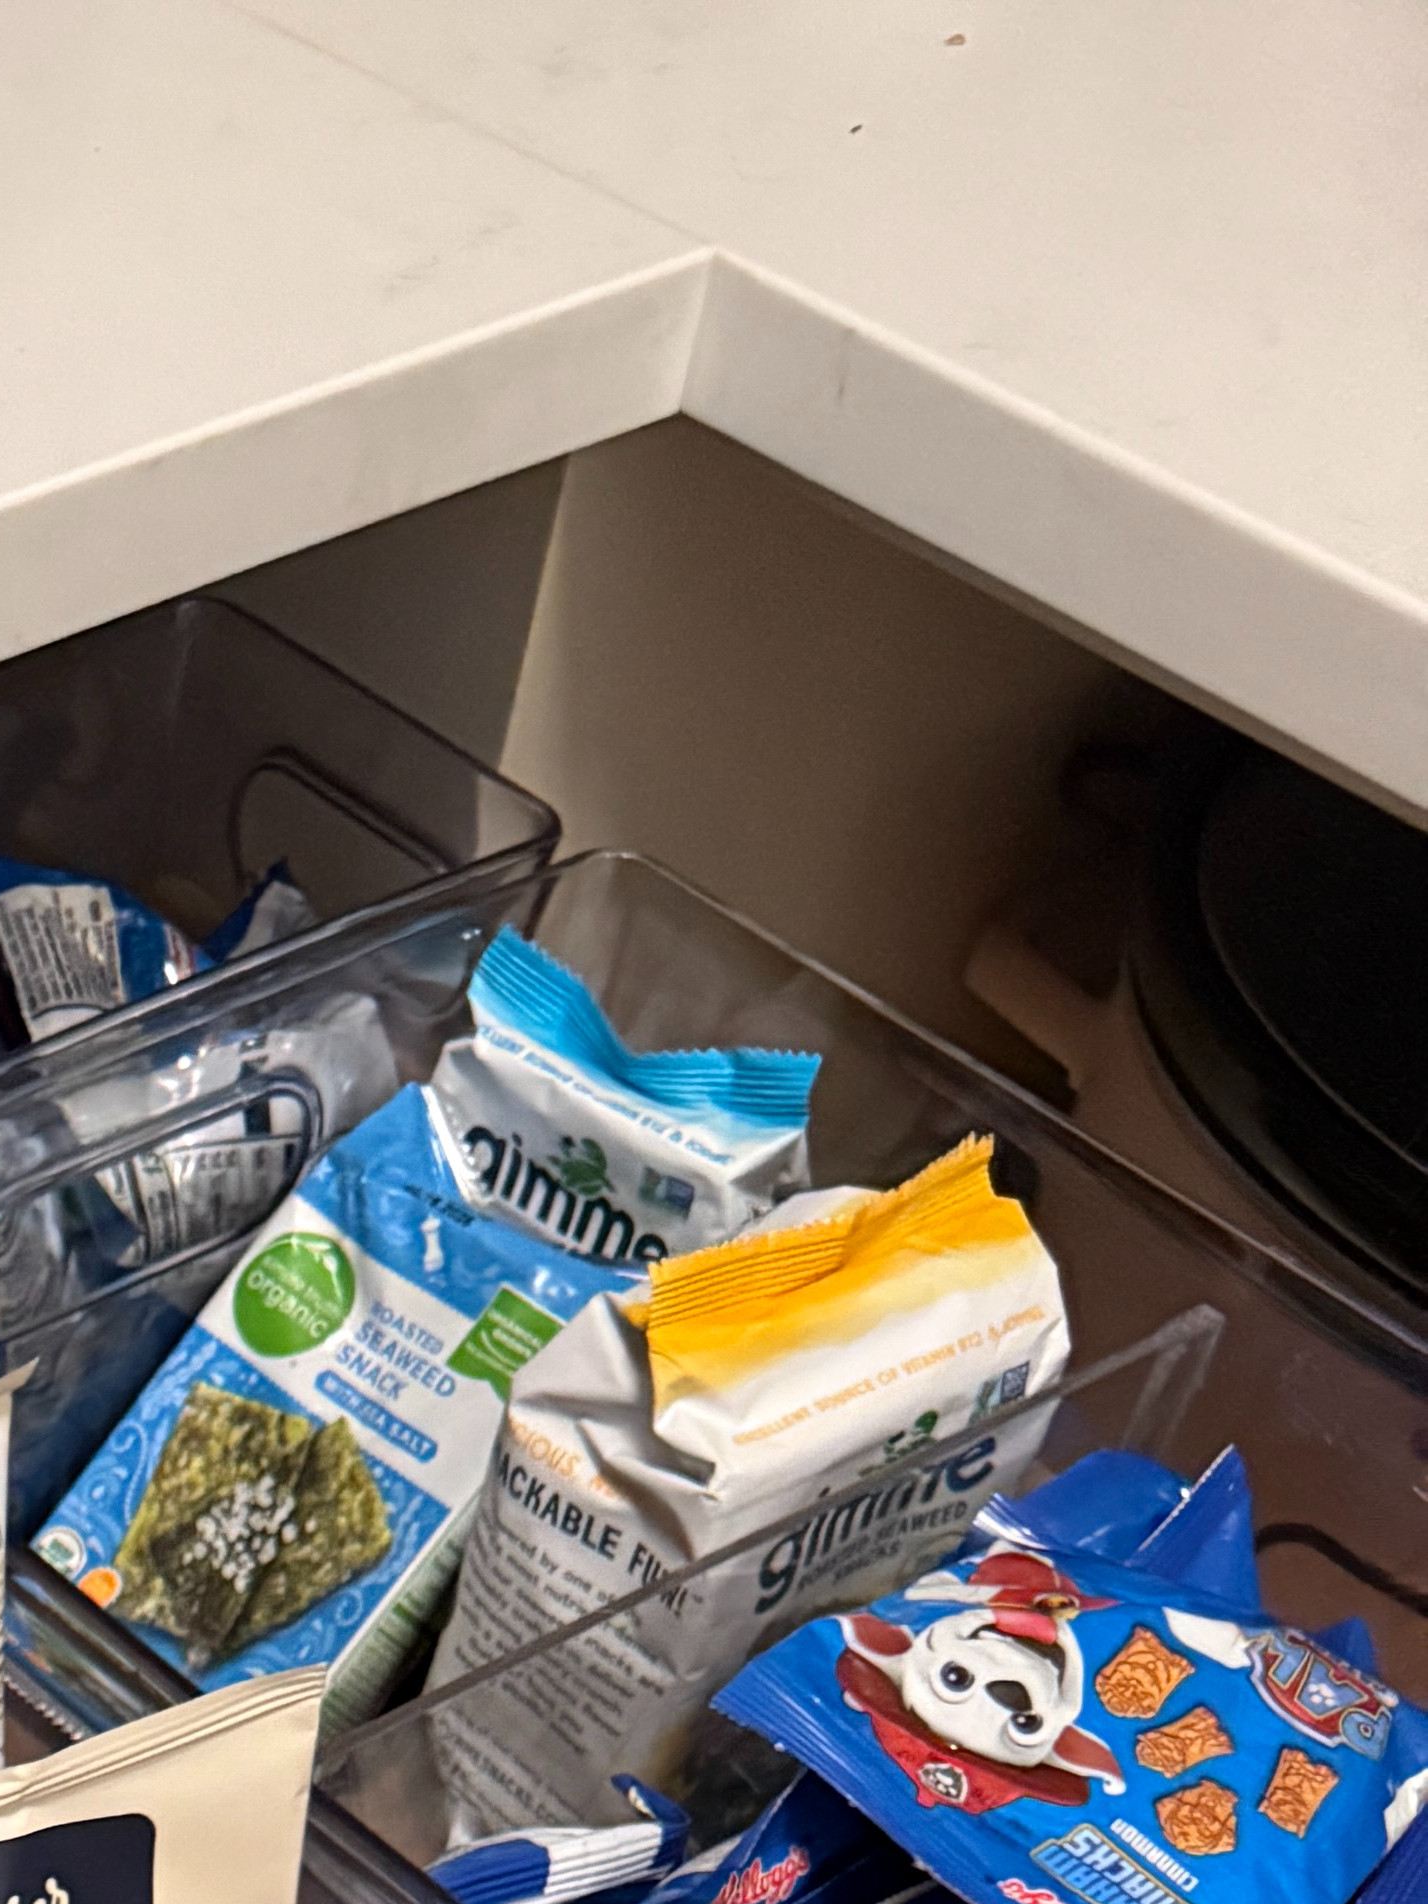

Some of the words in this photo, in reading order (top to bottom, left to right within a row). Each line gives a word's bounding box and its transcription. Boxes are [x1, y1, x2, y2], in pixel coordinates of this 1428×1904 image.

[246, 1271, 331, 1340] organic
[372, 1298, 446, 1356] ROASTED
[334, 1343, 409, 1403] SNACK
[353, 1318, 458, 1399] SEAWEED
[385, 1419, 433, 1458] SALT
[485, 1456, 631, 1561] ACKABLE
